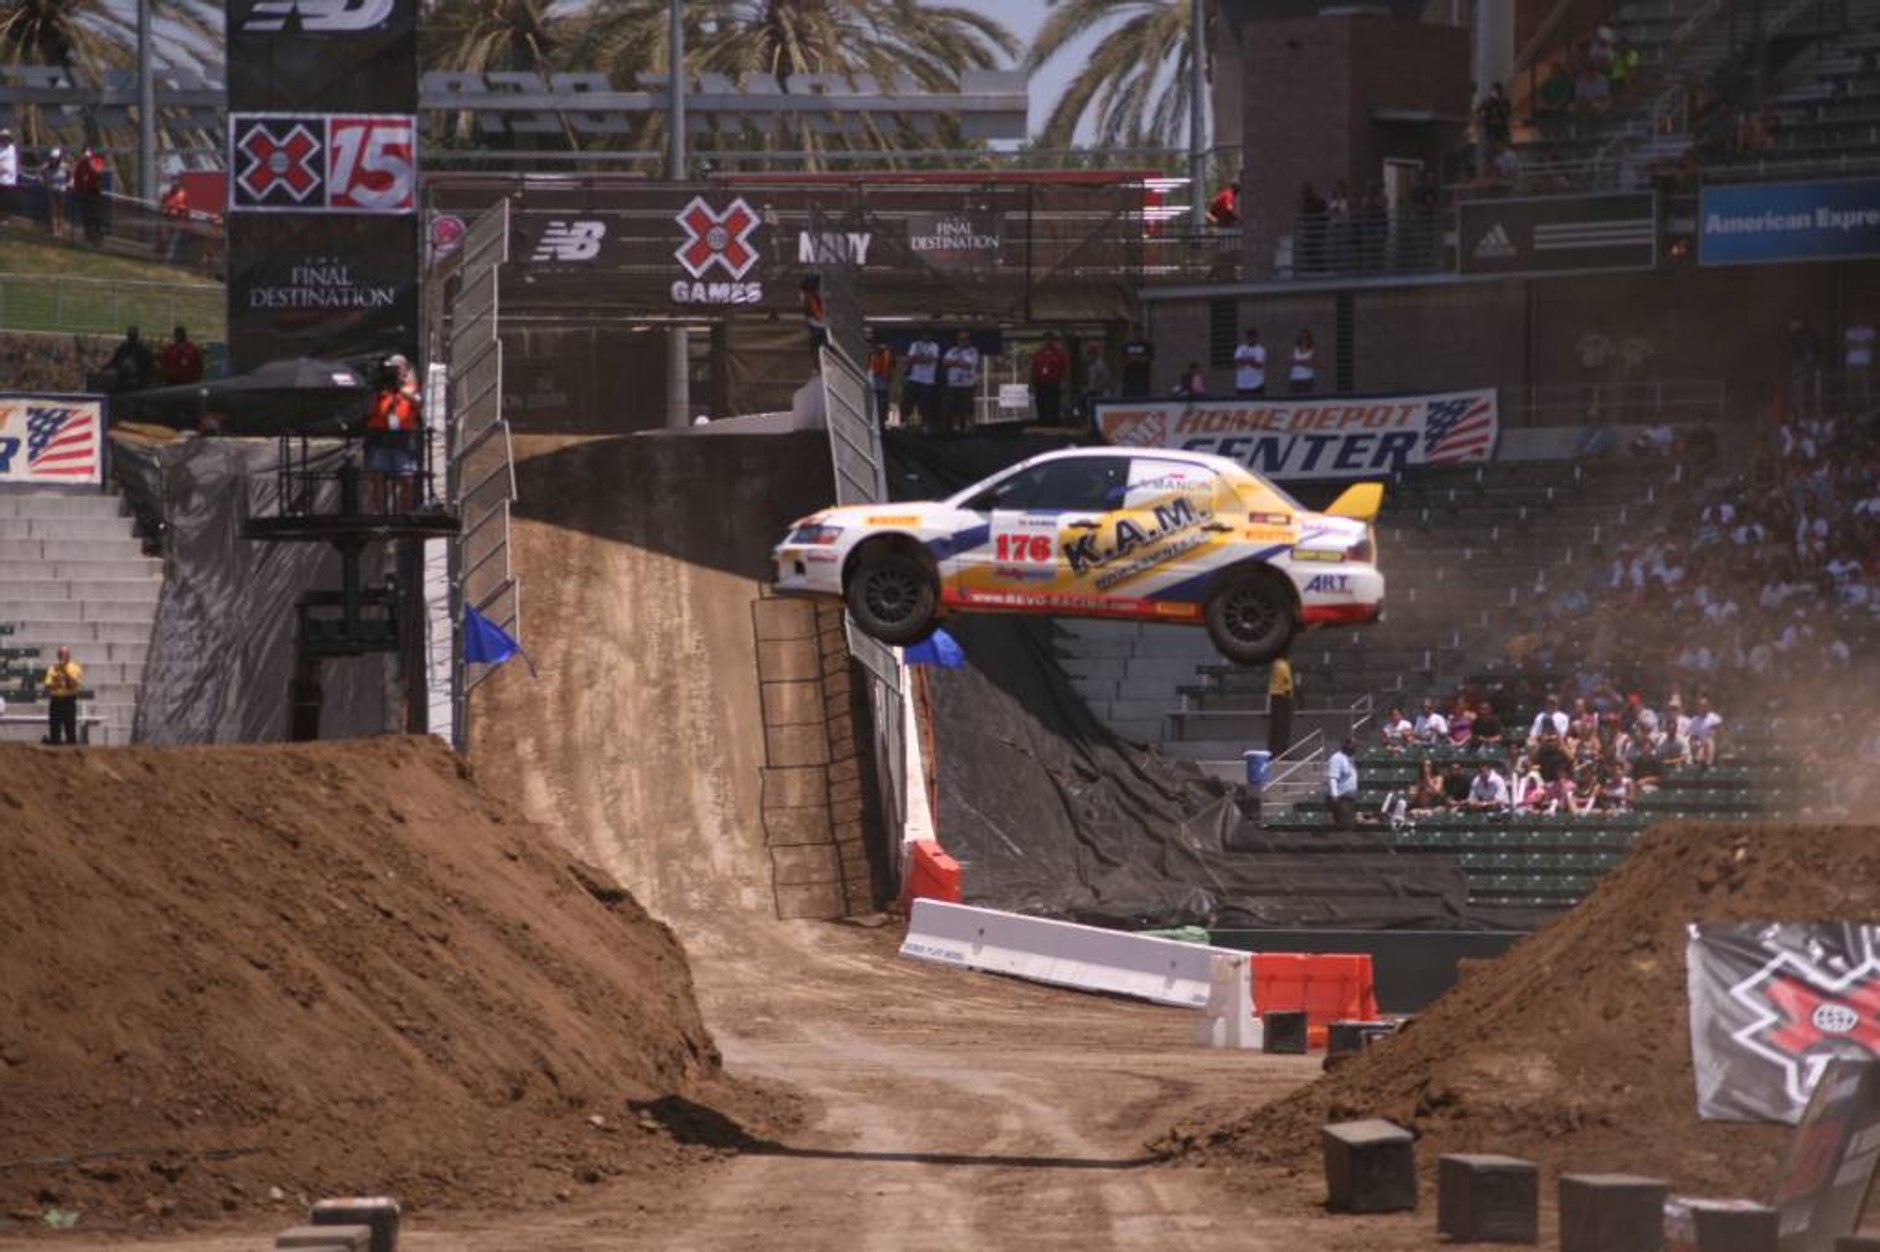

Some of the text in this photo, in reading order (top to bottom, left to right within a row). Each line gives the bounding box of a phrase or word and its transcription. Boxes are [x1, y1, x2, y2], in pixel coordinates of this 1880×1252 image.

[330, 126, 414, 209] 15
[936, 222, 972, 235] FINAL
[1705, 210, 1811, 234] American
[799, 231, 872, 266] NAVY
[911, 234, 1000, 252] DESTINATION
[291, 264, 352, 286] FINAL
[250, 287, 395, 308] DESTINATION
[670, 280, 763, 304] GAMES
[1175, 403, 1422, 434] HOME DEPOT
[996, 532, 1051, 562] 176
[1304, 574, 1350, 593] ART
